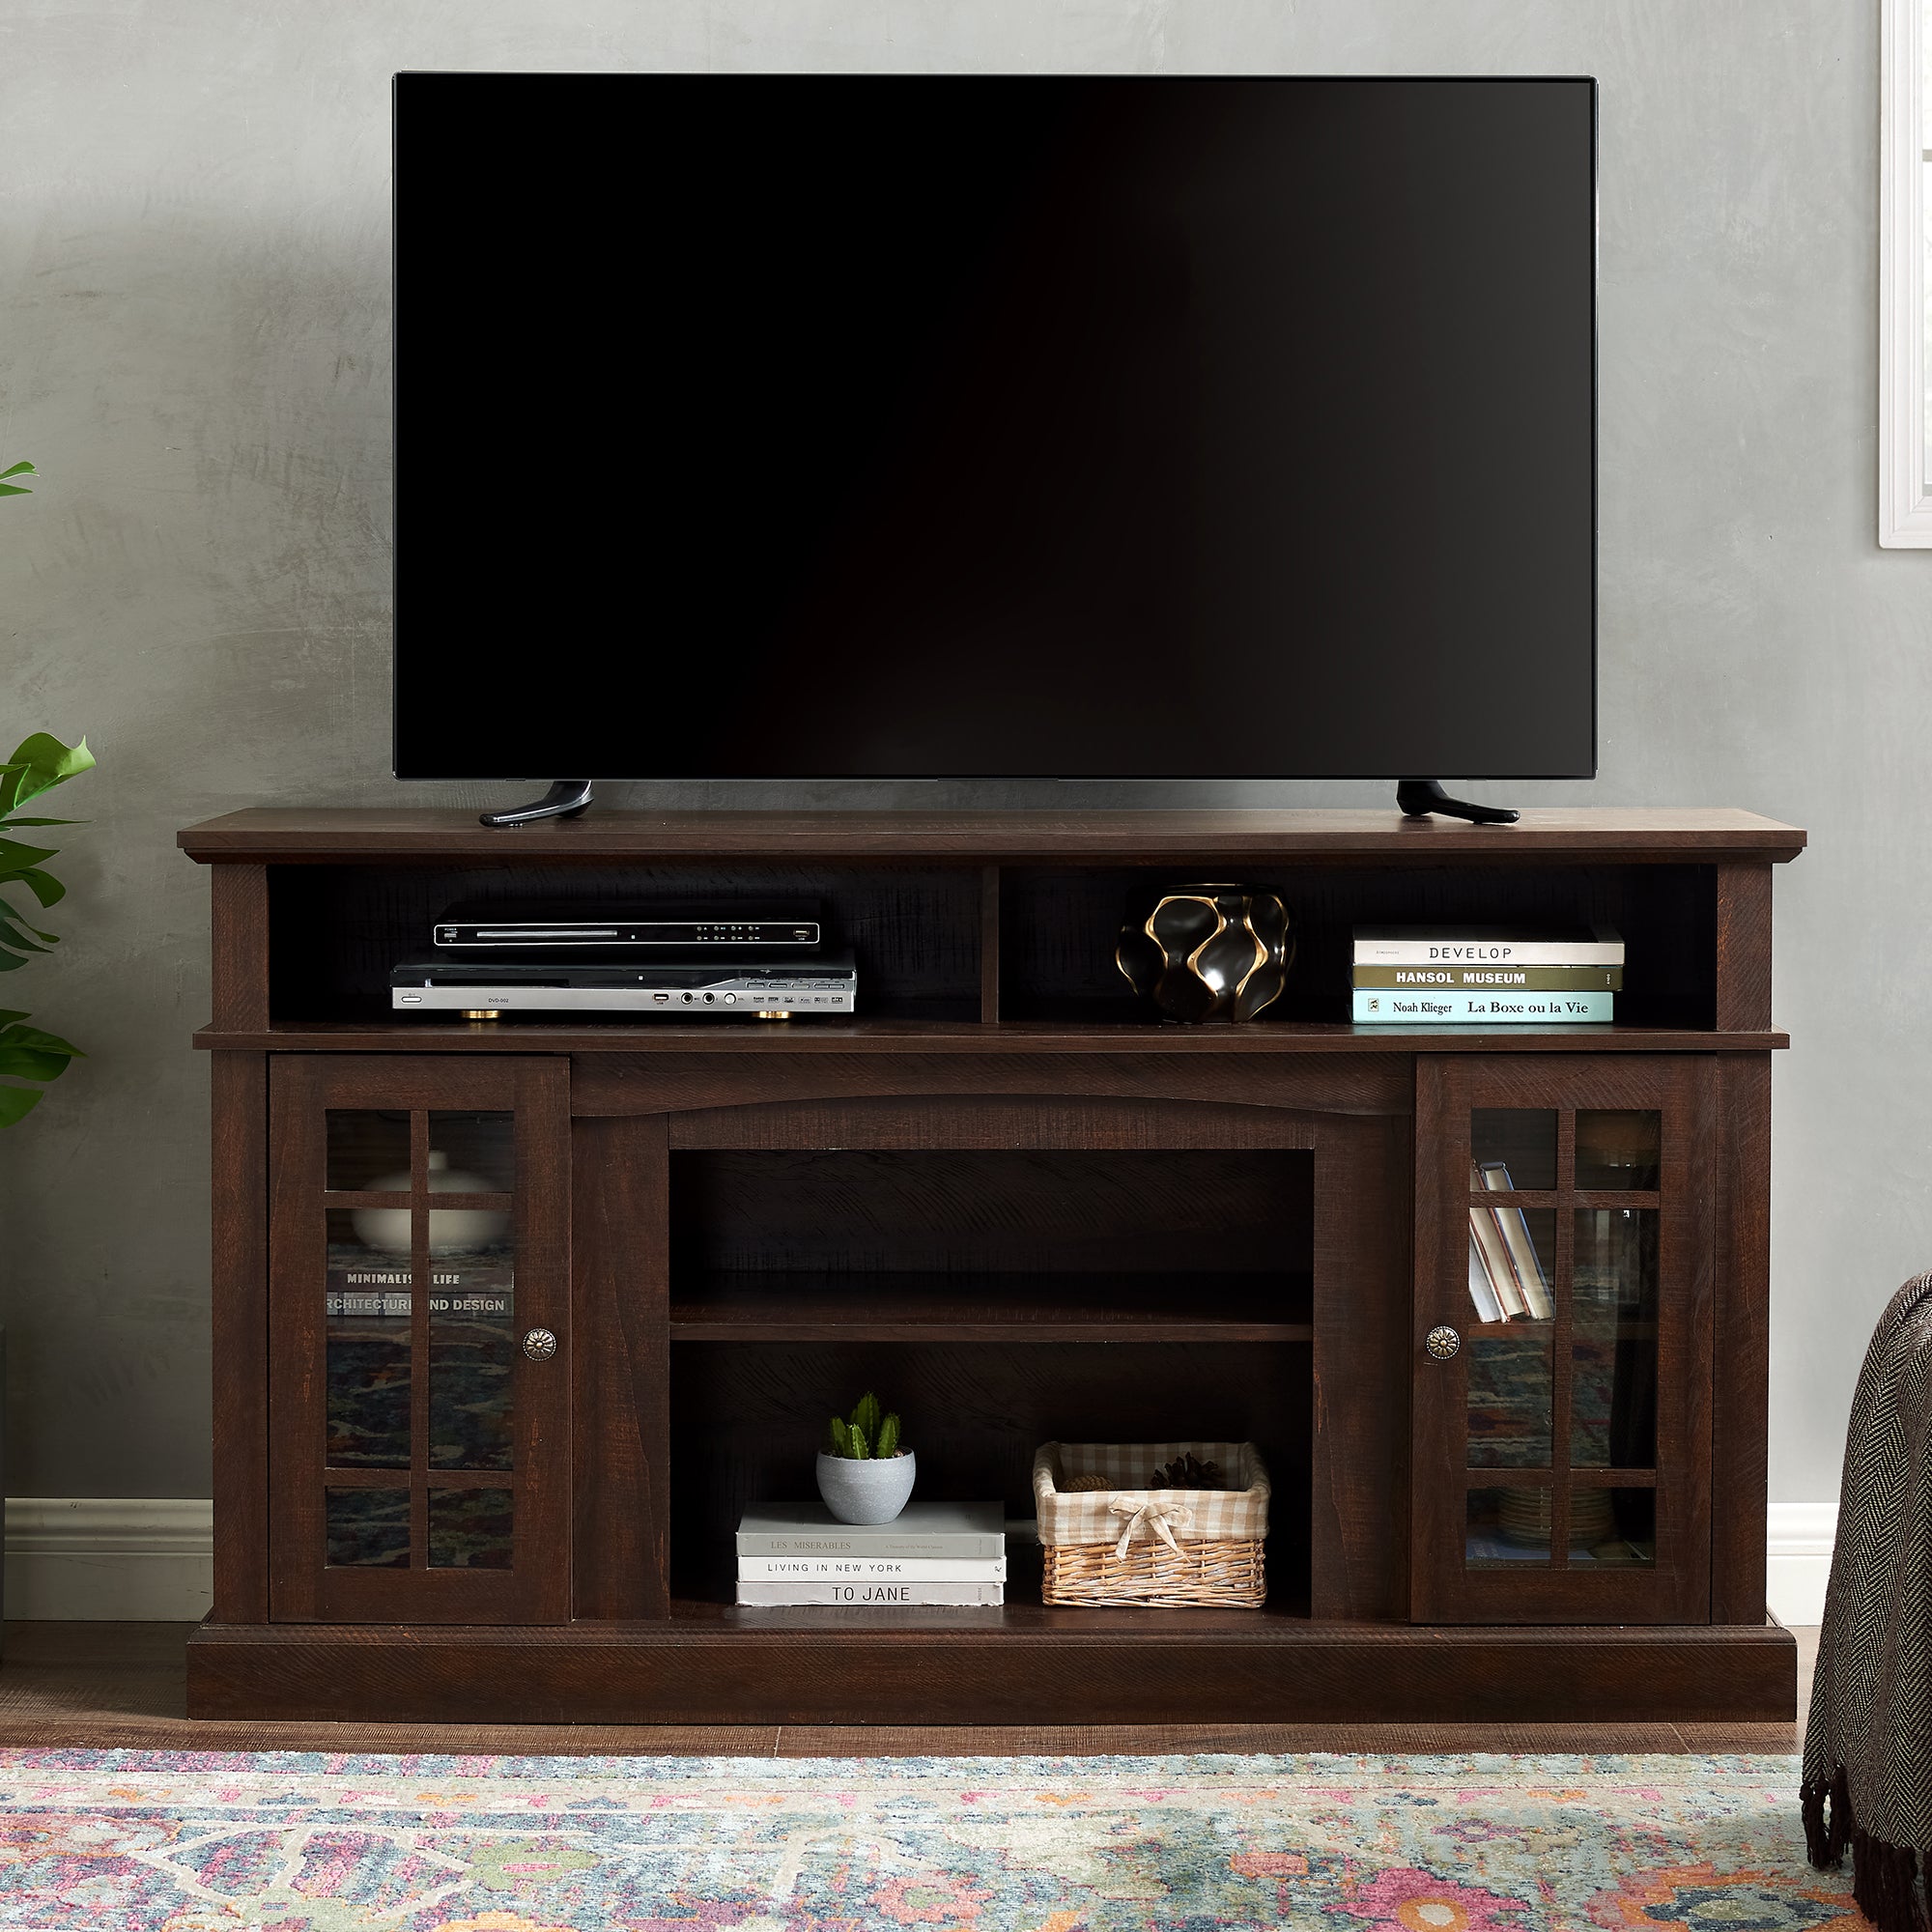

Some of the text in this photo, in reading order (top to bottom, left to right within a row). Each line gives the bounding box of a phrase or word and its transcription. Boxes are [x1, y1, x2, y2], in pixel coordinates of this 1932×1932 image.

[1429, 947, 1512, 959] DEVELOP
[1396, 972, 1526, 984] HANSOL MUSEUM
[1393, 1002, 1453, 1016] Noah Klieger
[1467, 1001, 1589, 1013] La Boxe ou la Vie
[347, 1273, 460, 1285] MINIMALIS LIFE
[327, 1298, 505, 1311] RCHITECTUR ND DESIGN
[771, 1541, 851, 1549] LES MISERABLES
[767, 1563, 902, 1573] LIVING IN NEW YORK
[832, 1586, 910, 1602] TO JANE
